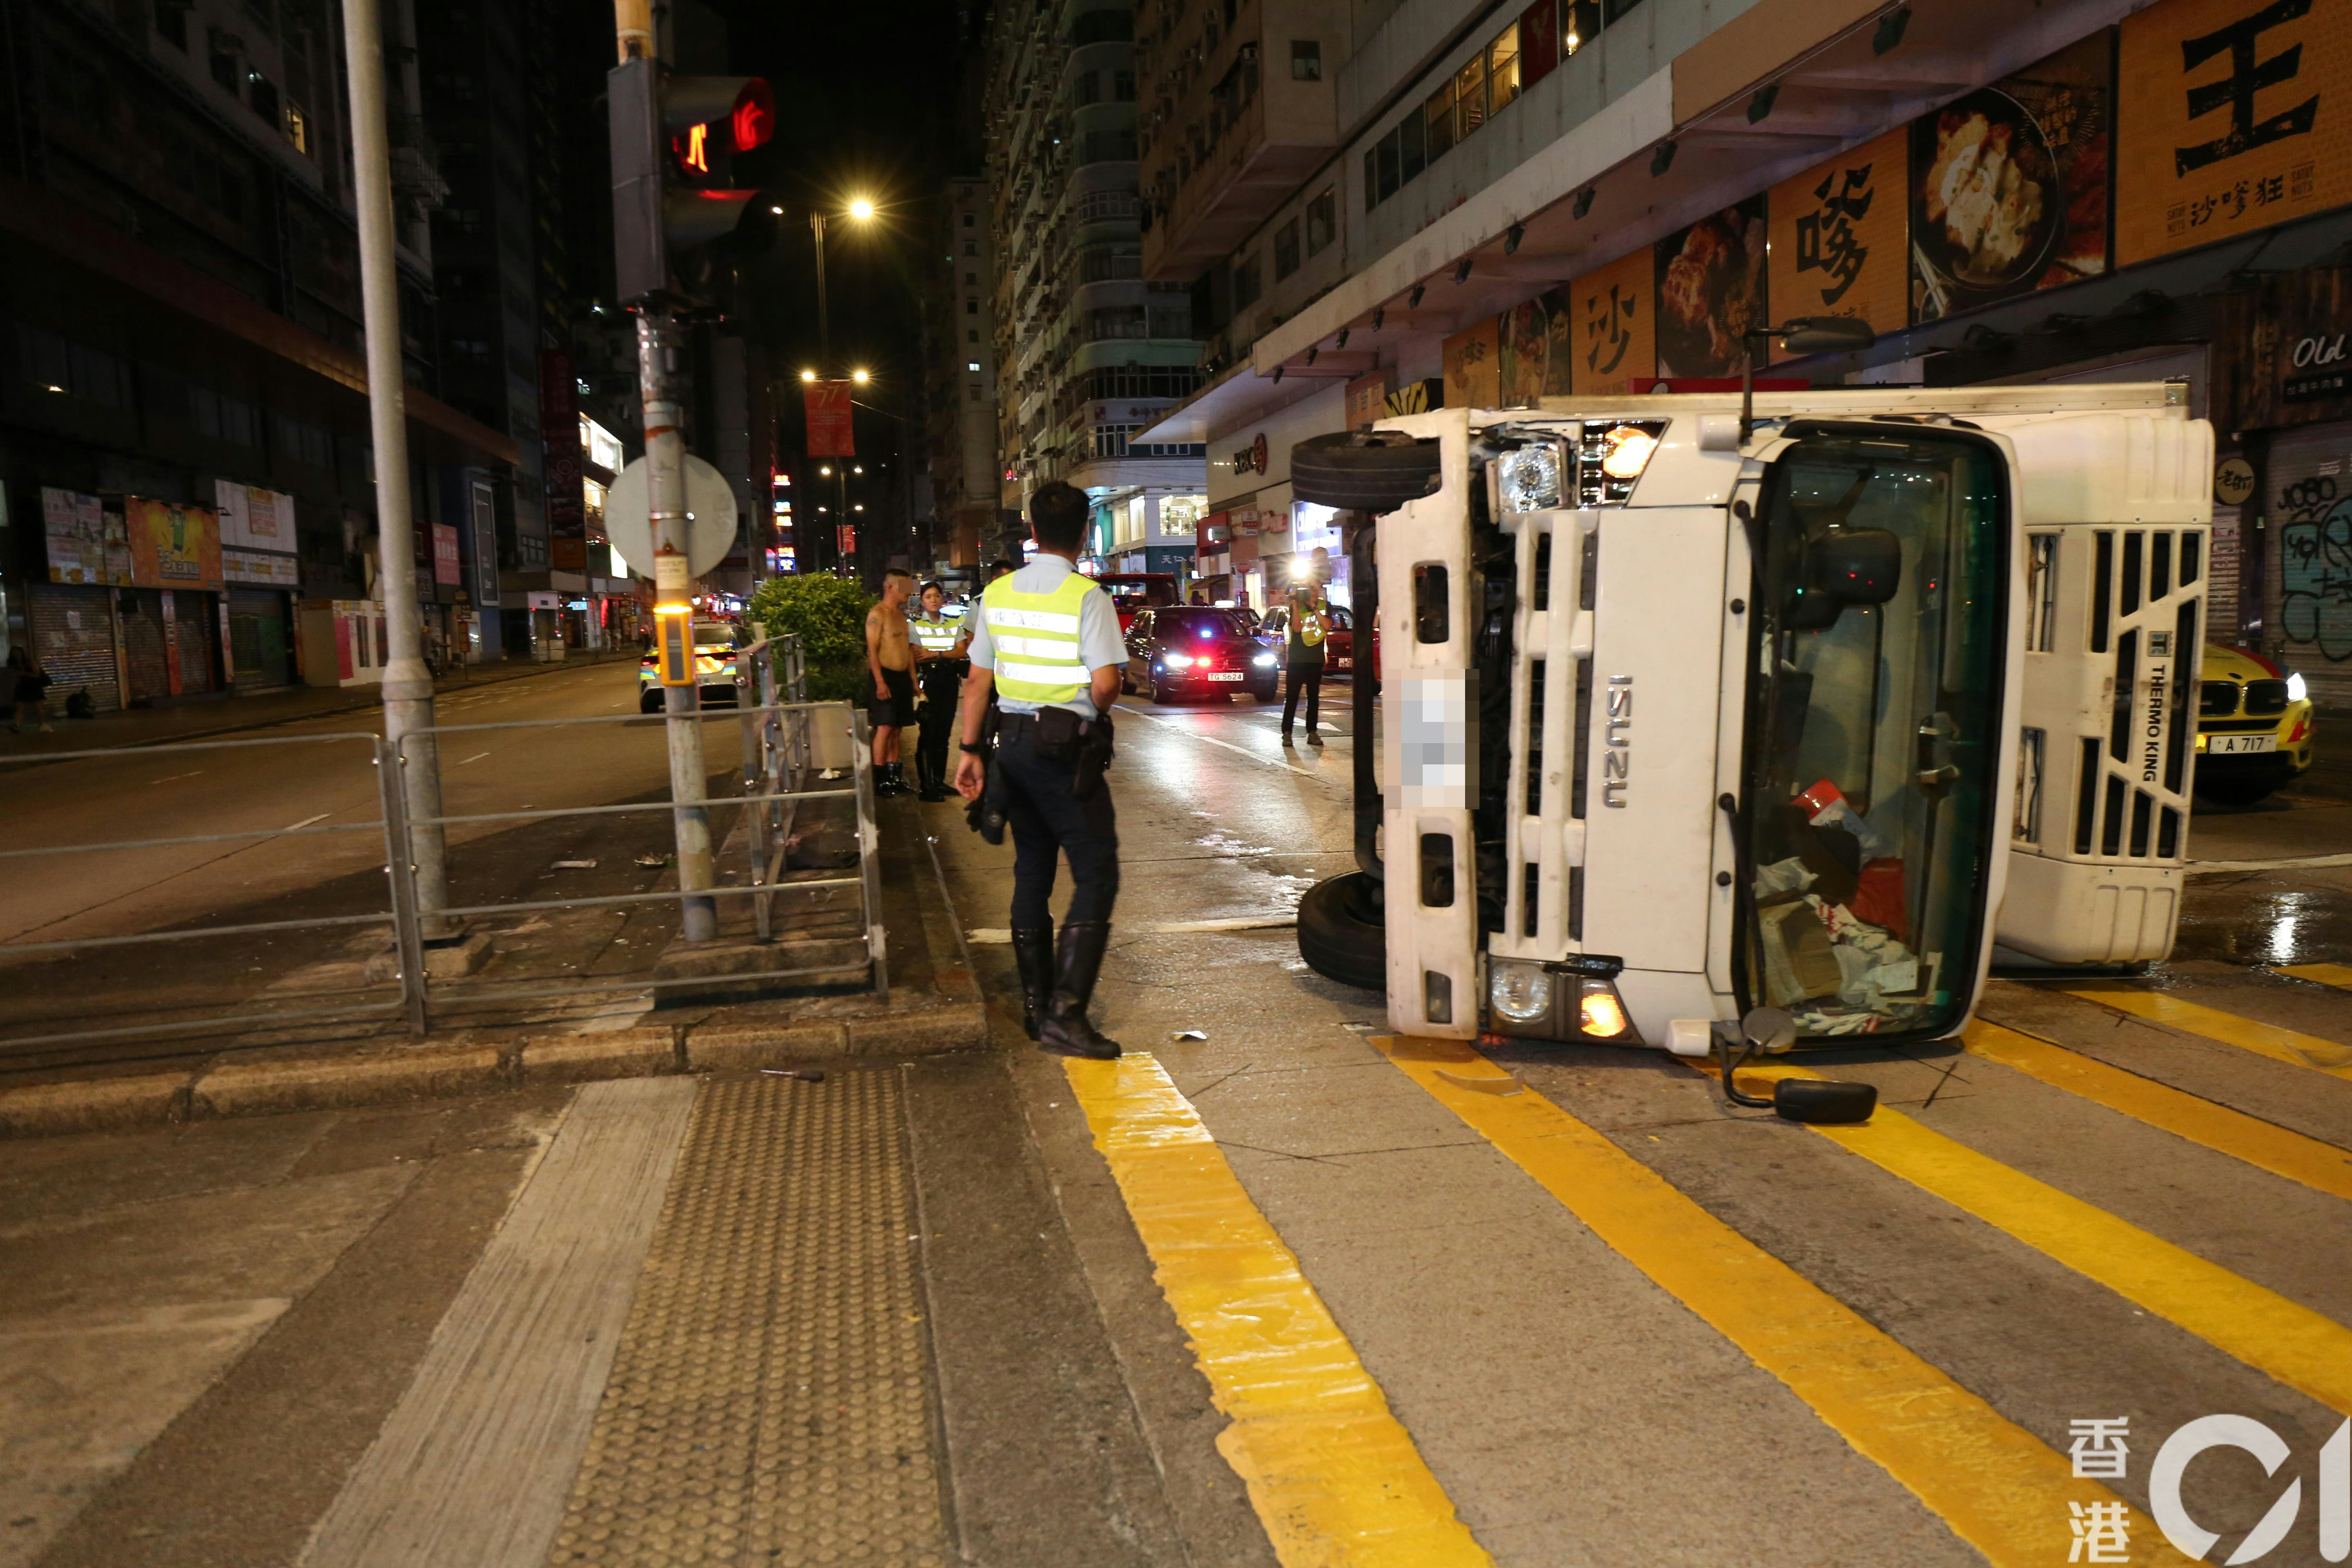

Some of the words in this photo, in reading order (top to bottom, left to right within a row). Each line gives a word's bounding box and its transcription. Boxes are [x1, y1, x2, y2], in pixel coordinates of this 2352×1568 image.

[2176, 0, 2321, 178] 王
[2291, 180, 2314, 195] NUTS
[1796, 163, 1874, 306] 嗲
[1588, 285, 1636, 375] 沙
[2292, 334, 2348, 368] Old
[2146, 664, 2166, 738] THERMO
[1602, 675, 1633, 808] ISUZU
[2142, 741, 2162, 782] KING
[2225, 738, 2234, 751] A
[2241, 737, 2264, 751] 717
